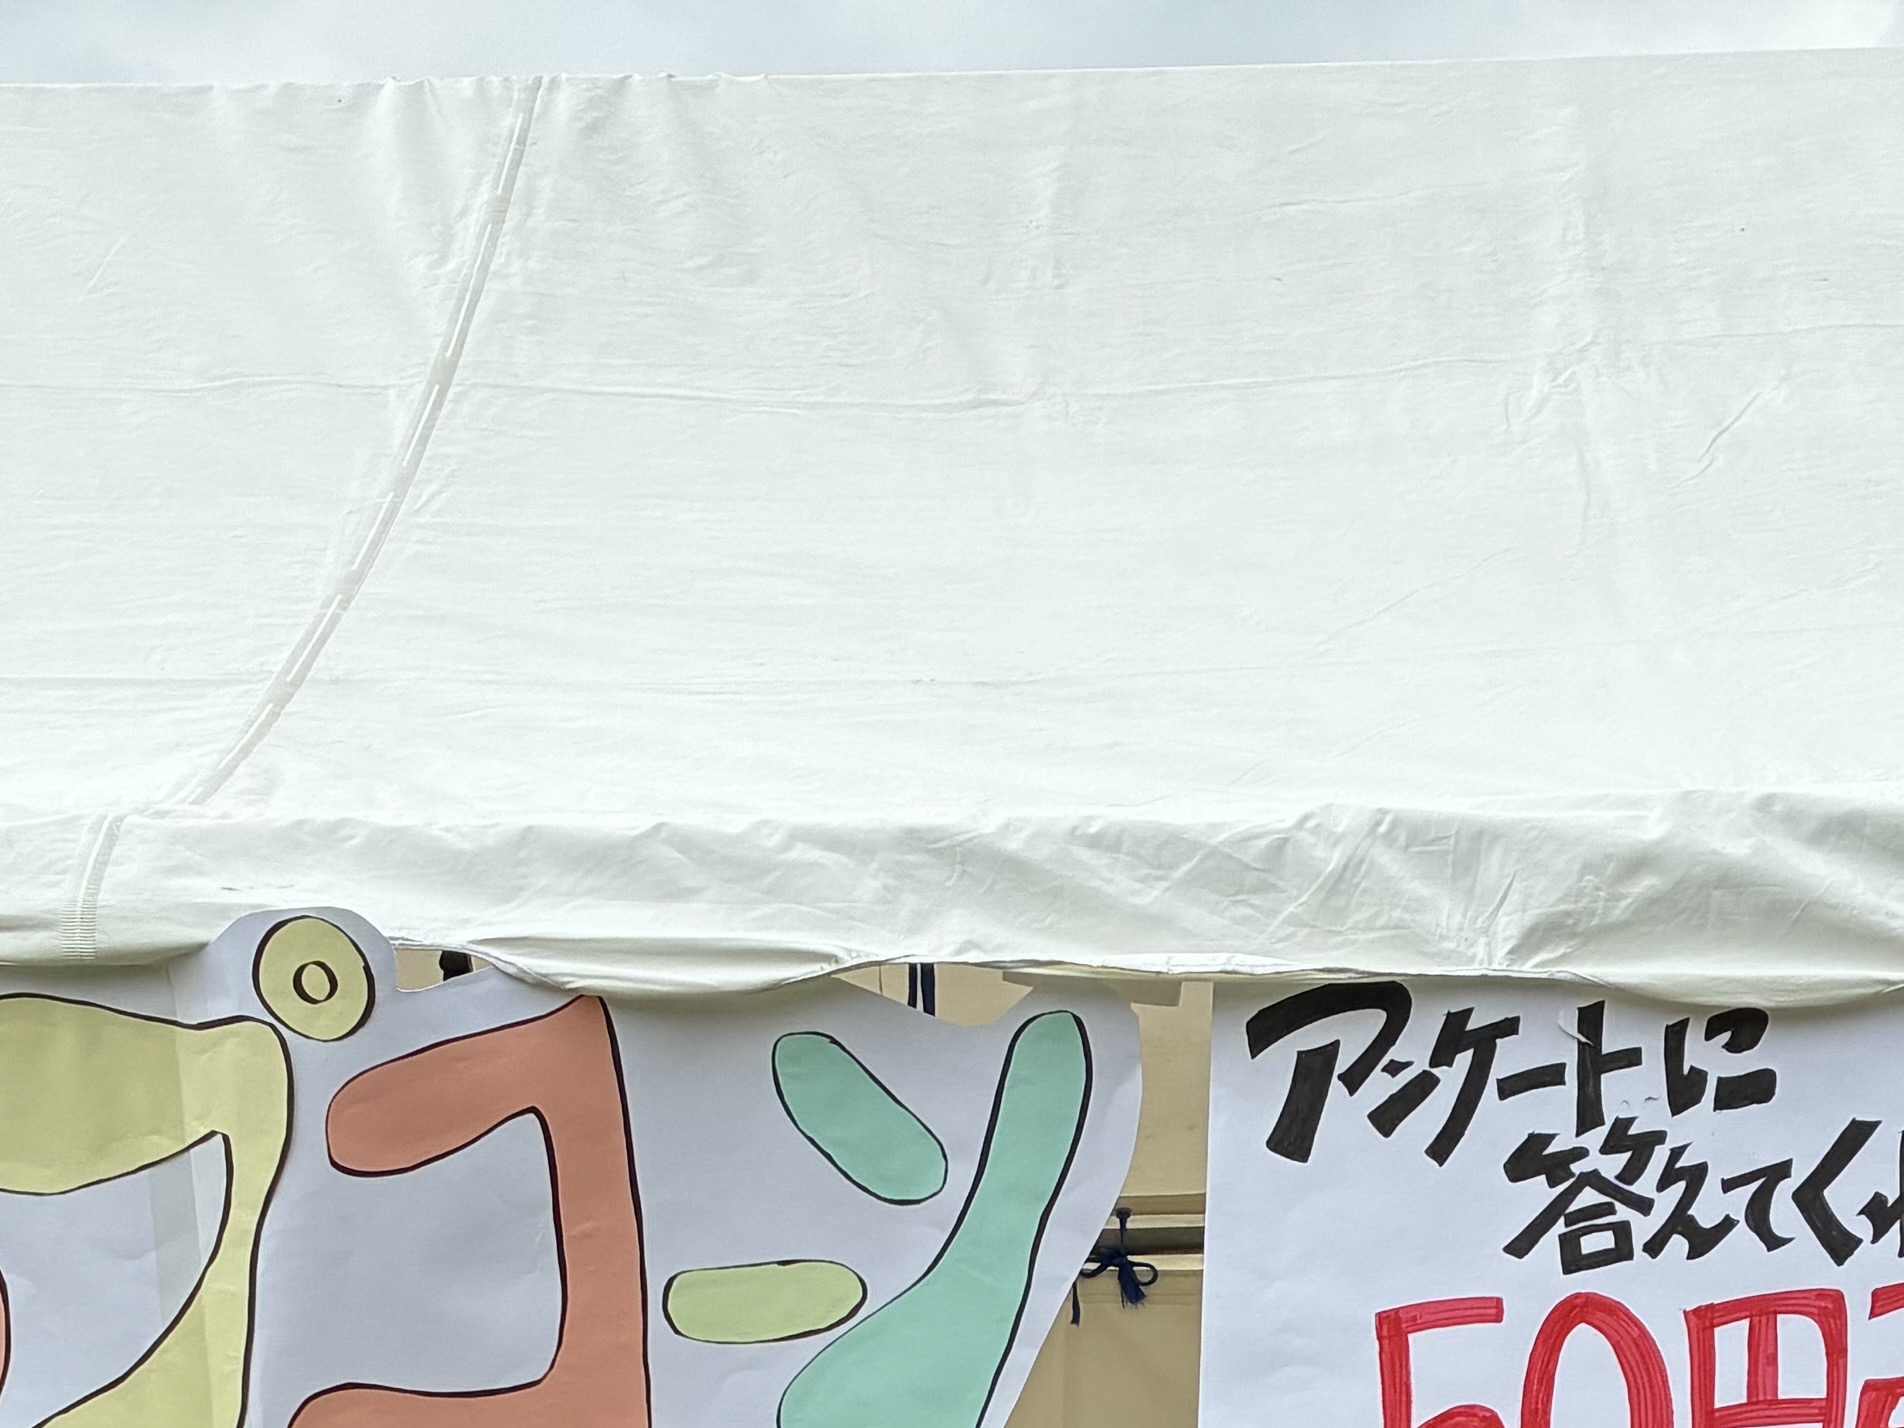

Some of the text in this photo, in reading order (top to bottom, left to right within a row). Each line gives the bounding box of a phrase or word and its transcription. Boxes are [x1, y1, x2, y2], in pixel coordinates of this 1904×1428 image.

[1247, 982, 1777, 1164] アンケートに
